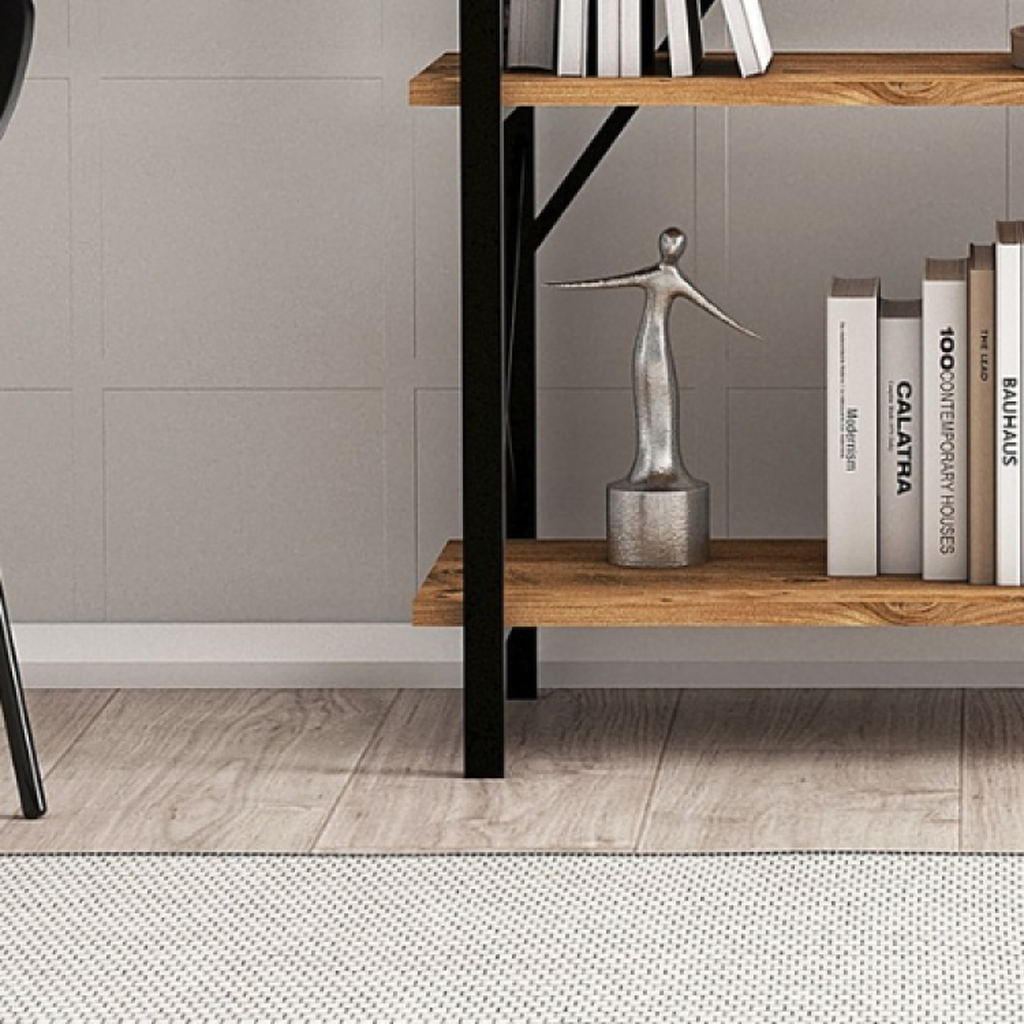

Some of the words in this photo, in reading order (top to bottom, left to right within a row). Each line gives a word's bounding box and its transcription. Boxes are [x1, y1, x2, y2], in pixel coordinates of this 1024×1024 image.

[847, 408, 858, 472] Modernism
[896, 380, 912, 496] CALATRA
[1002, 377, 1018, 466] BAUHAUS
[939, 495, 955, 555] HOUSES
